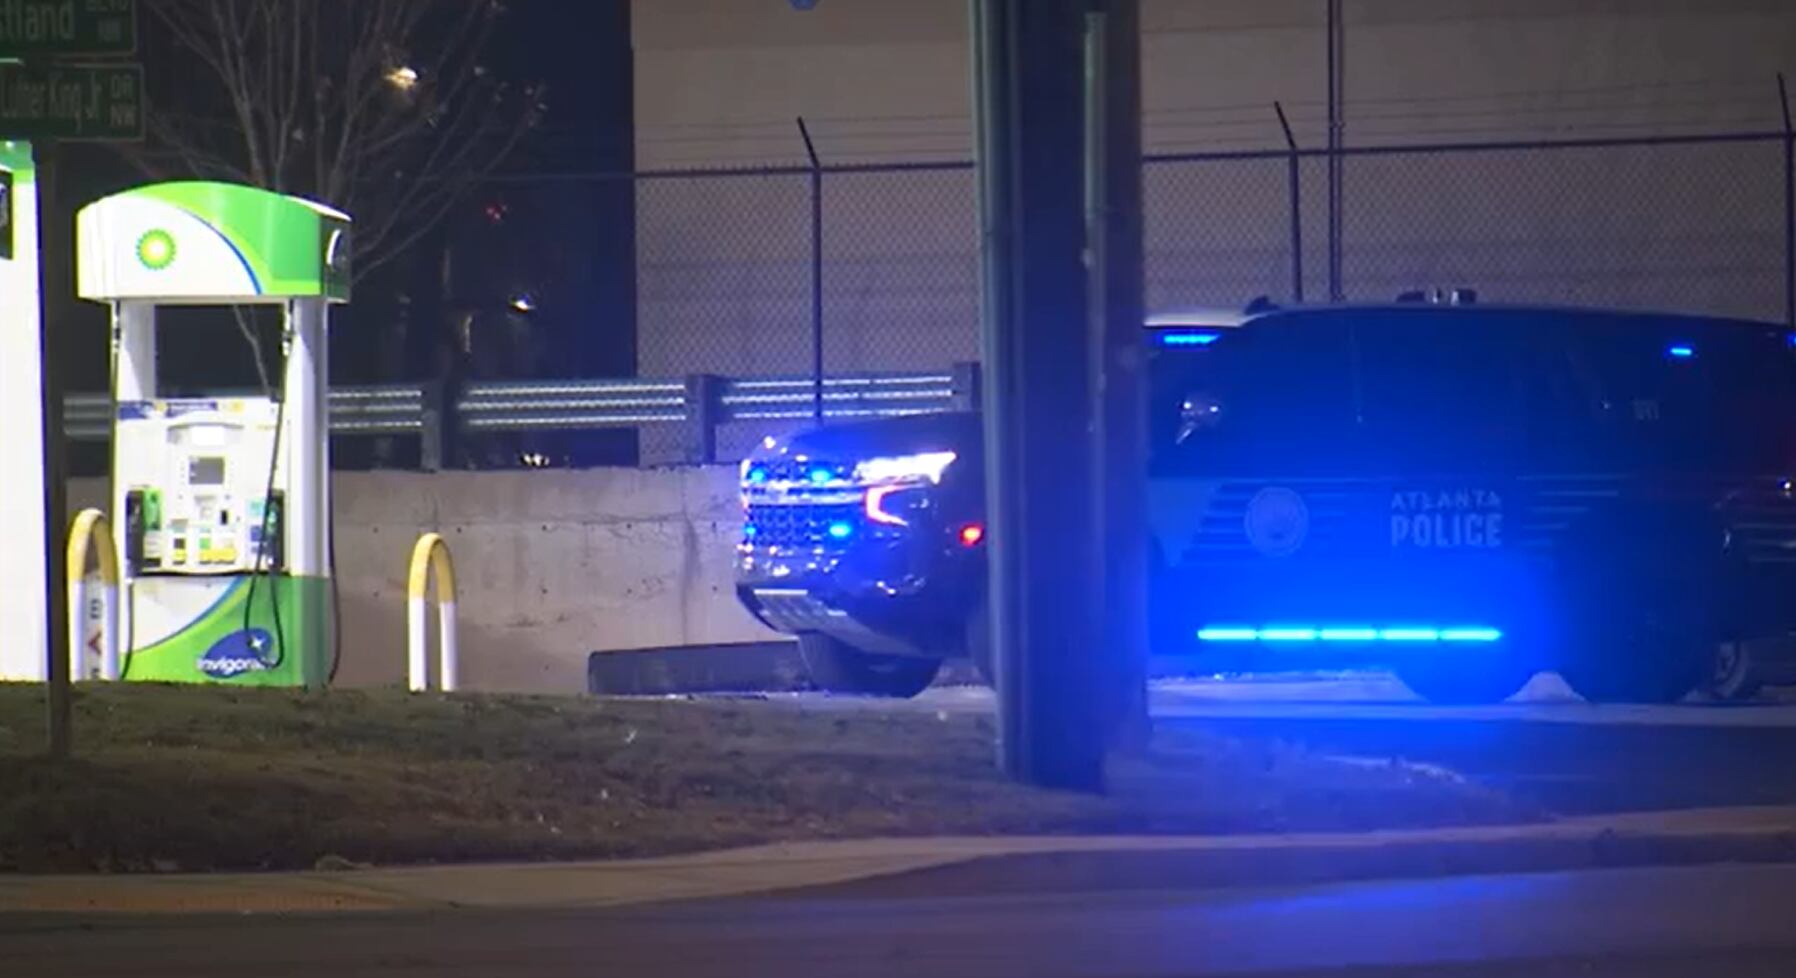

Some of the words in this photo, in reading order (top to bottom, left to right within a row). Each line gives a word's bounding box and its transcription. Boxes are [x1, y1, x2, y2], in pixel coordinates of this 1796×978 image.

[0, 0, 75, 43] tland
[1391, 488, 1502, 511] ATLANTA
[1391, 513, 1504, 548] POLICE
